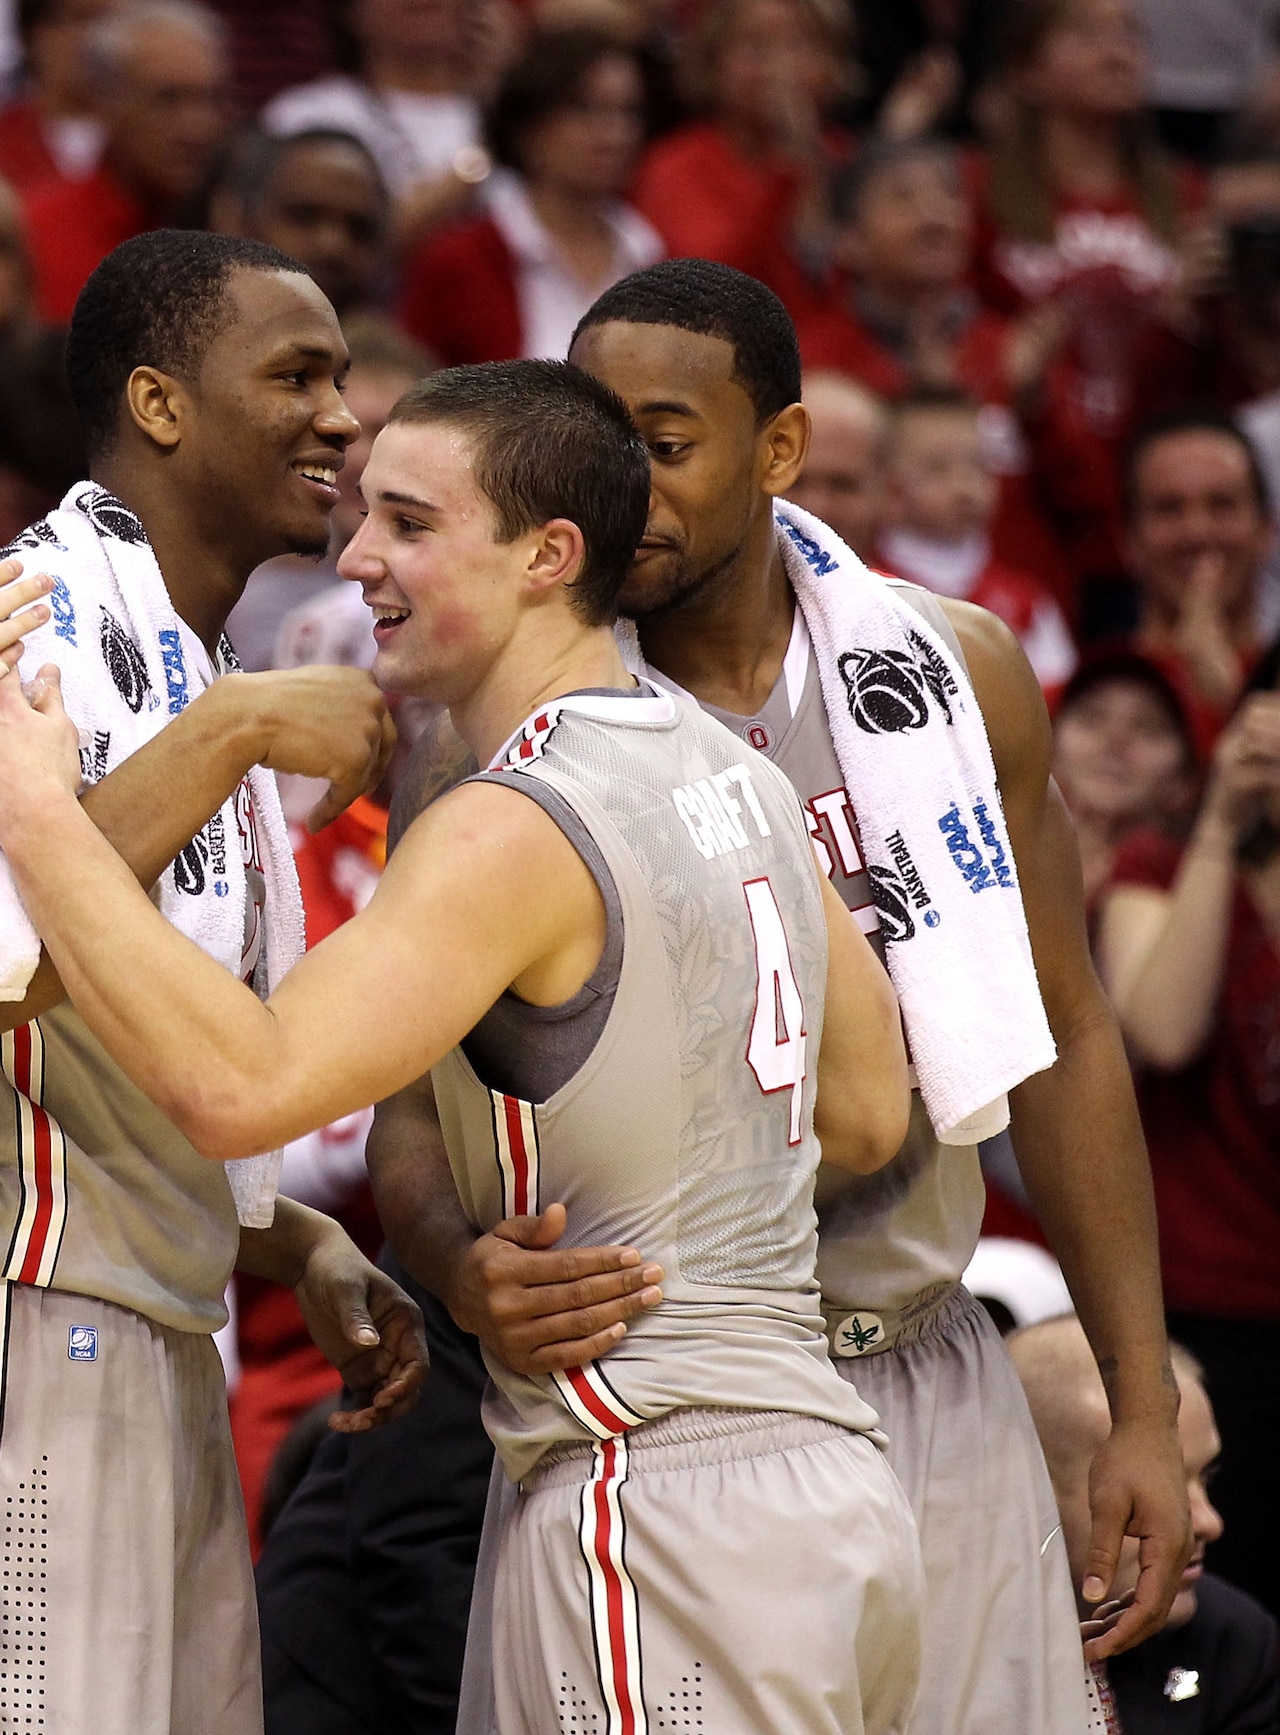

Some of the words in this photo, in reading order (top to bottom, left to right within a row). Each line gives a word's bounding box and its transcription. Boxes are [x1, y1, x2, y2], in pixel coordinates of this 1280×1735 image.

[672, 762, 771, 861] CRAFT
[938, 807, 998, 894] NCAA
[884, 829, 932, 910] BASKETBALL
[744, 876, 808, 1149] 4
[74, 1350, 91, 1358] NCAA
